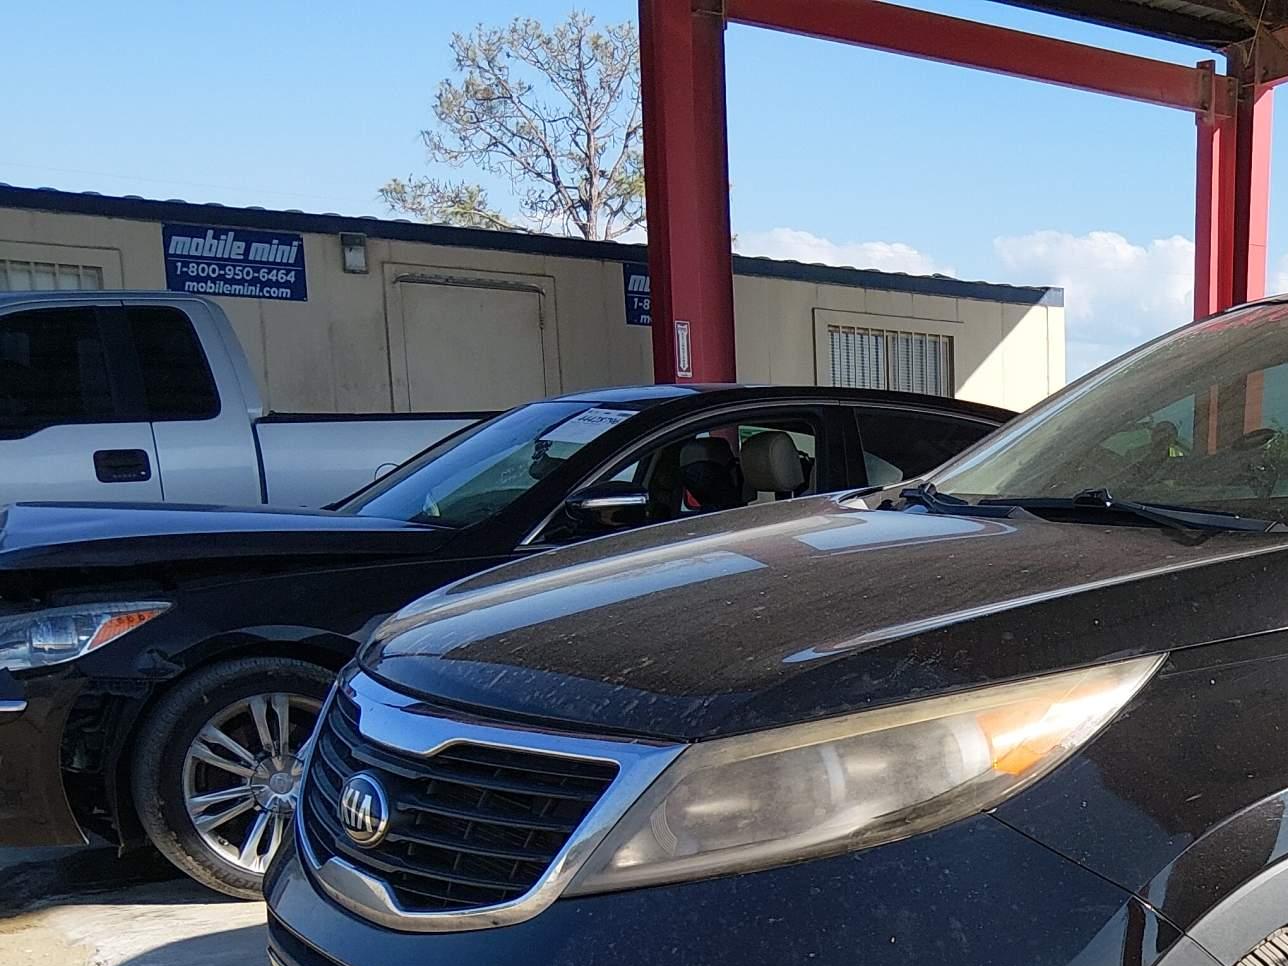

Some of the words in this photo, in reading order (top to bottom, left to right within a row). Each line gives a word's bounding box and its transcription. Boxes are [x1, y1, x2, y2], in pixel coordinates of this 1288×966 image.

[168, 229, 246, 259] mobile
[249, 239, 299, 264] mini
[175, 262, 296, 283] 1-800-950-6464
[184, 280, 291, 298] mobilemini.com
[342, 786, 373, 833] KIA
